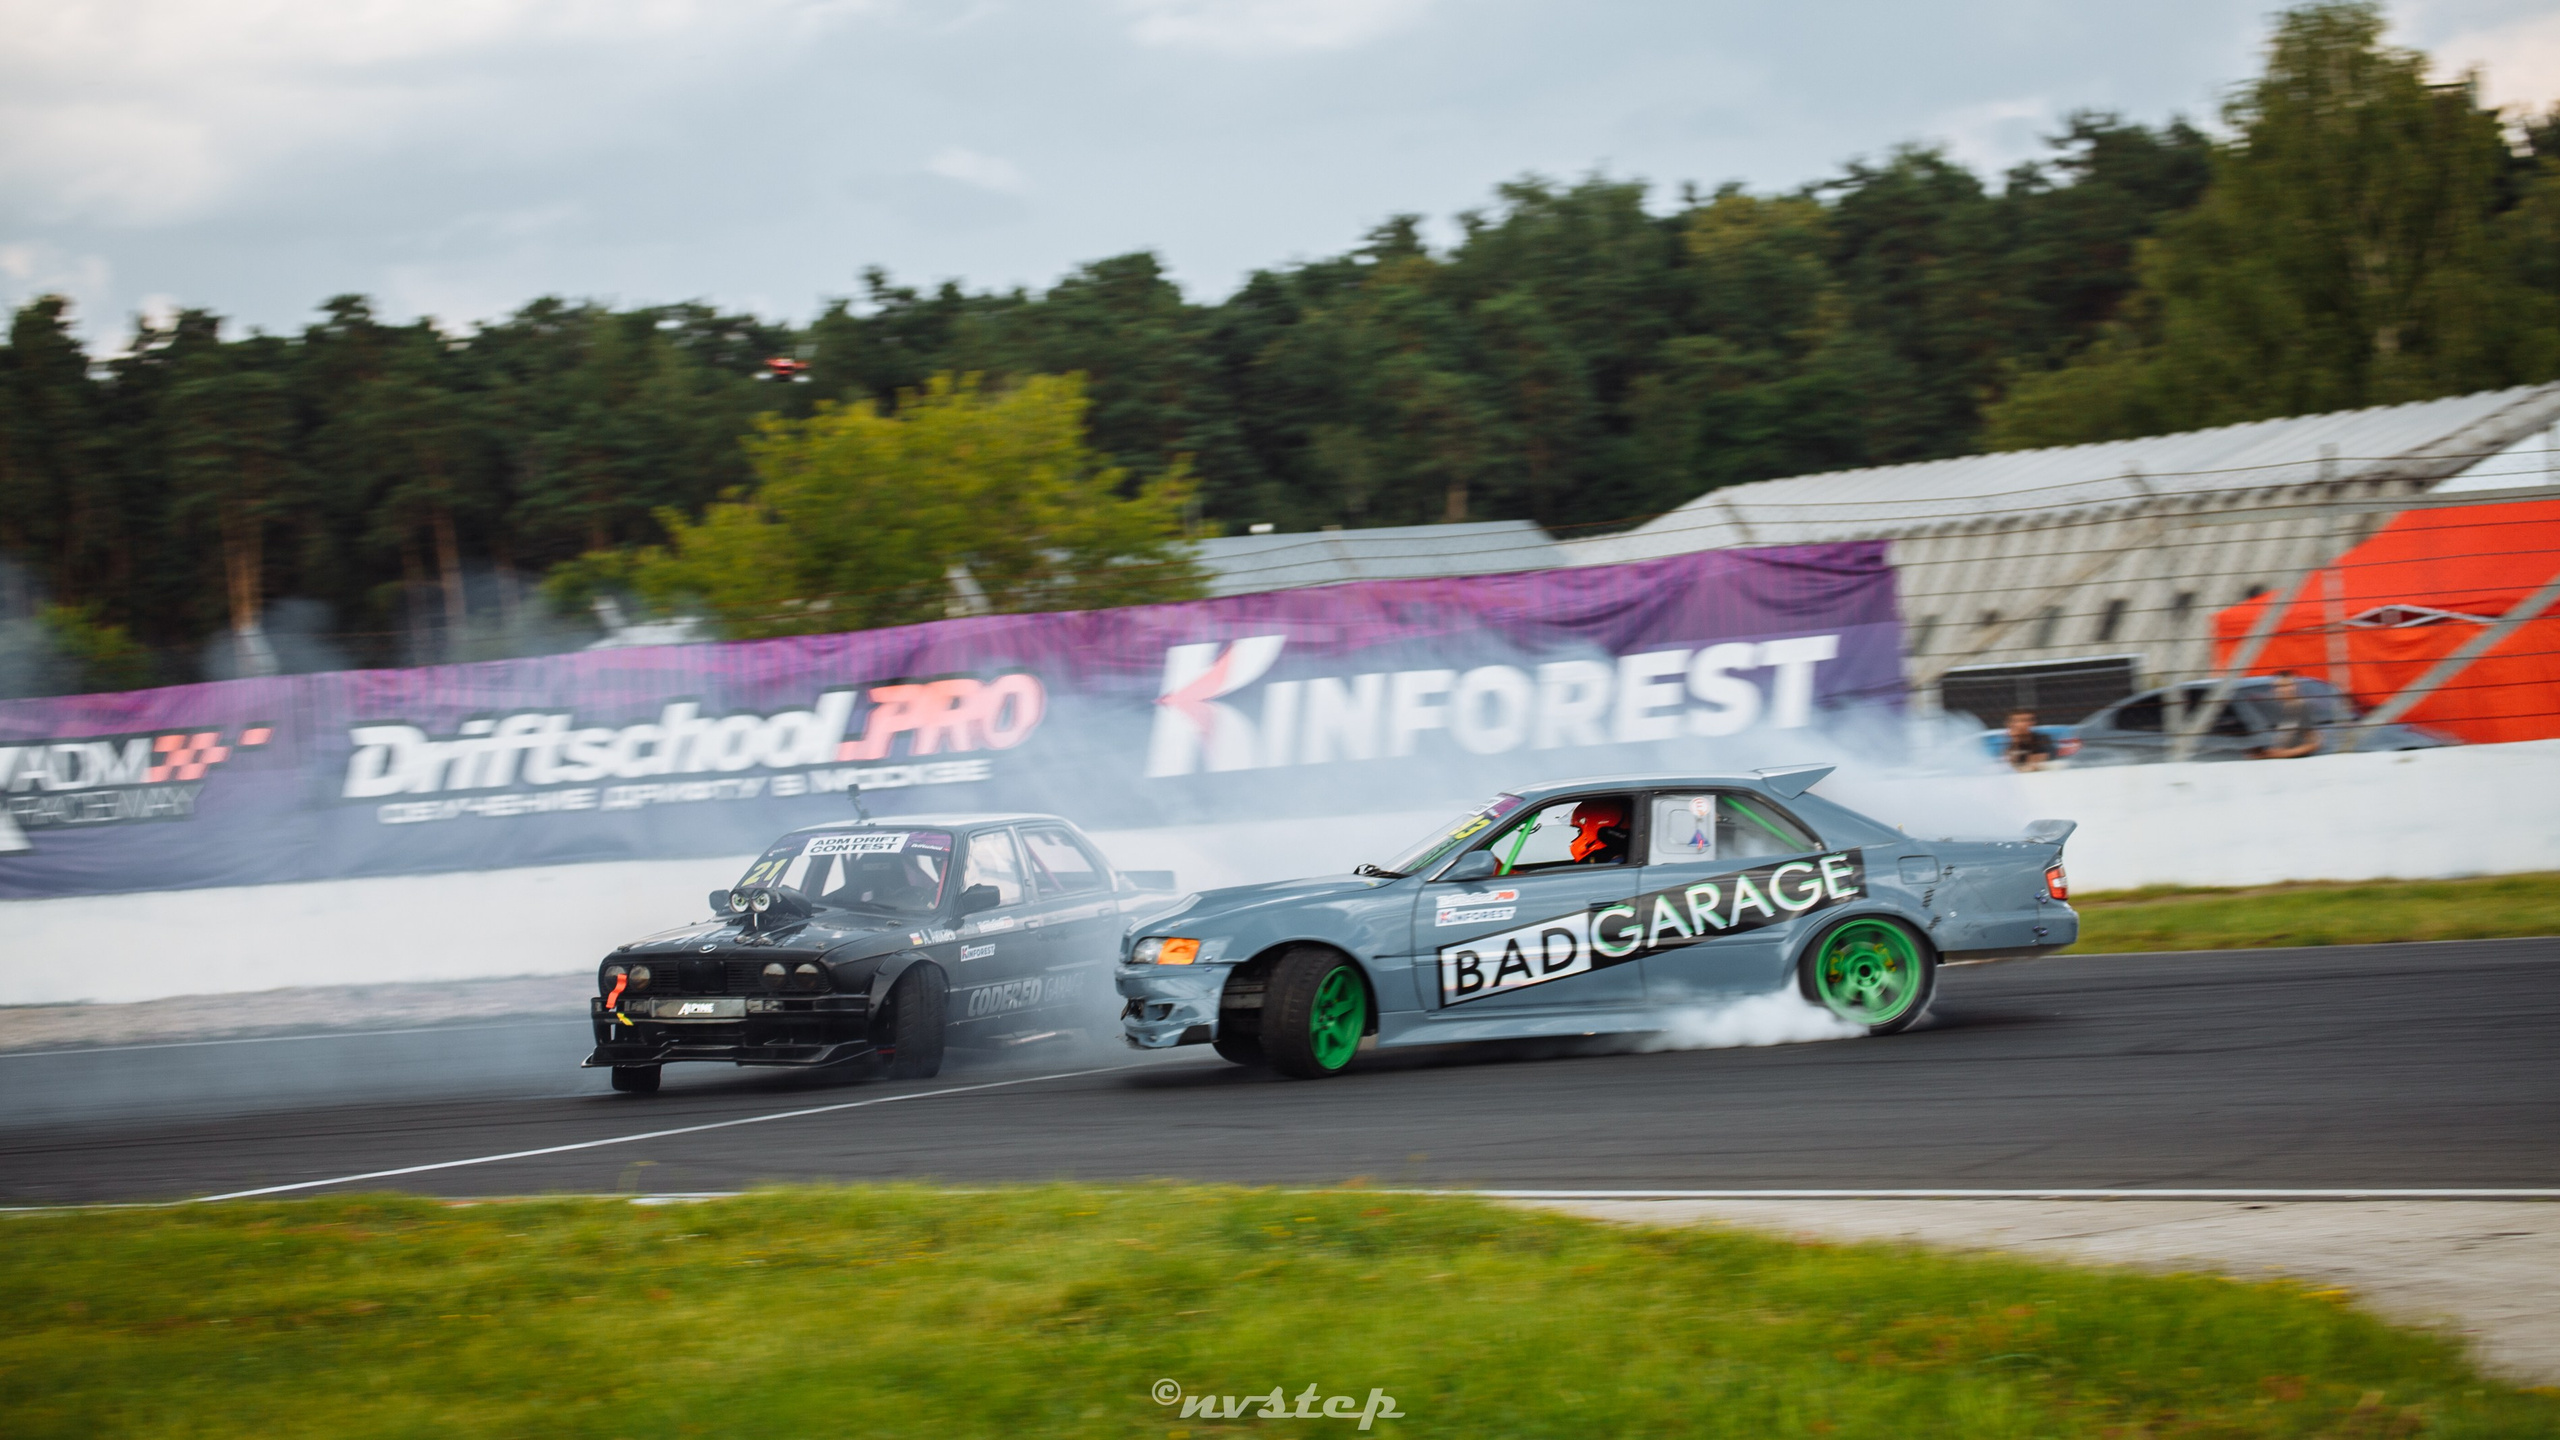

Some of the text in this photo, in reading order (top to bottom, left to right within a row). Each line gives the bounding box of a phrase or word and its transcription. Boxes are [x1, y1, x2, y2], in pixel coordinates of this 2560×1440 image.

[1146, 634, 1840, 778] KINFOREST
[810, 843, 897, 853] CONTEST
[813, 836, 901, 846] ADM DRIFT
[741, 858, 789, 887] 21
[1455, 853, 1860, 998] BAD GARAGE
[961, 945, 995, 960] KINFOREST
